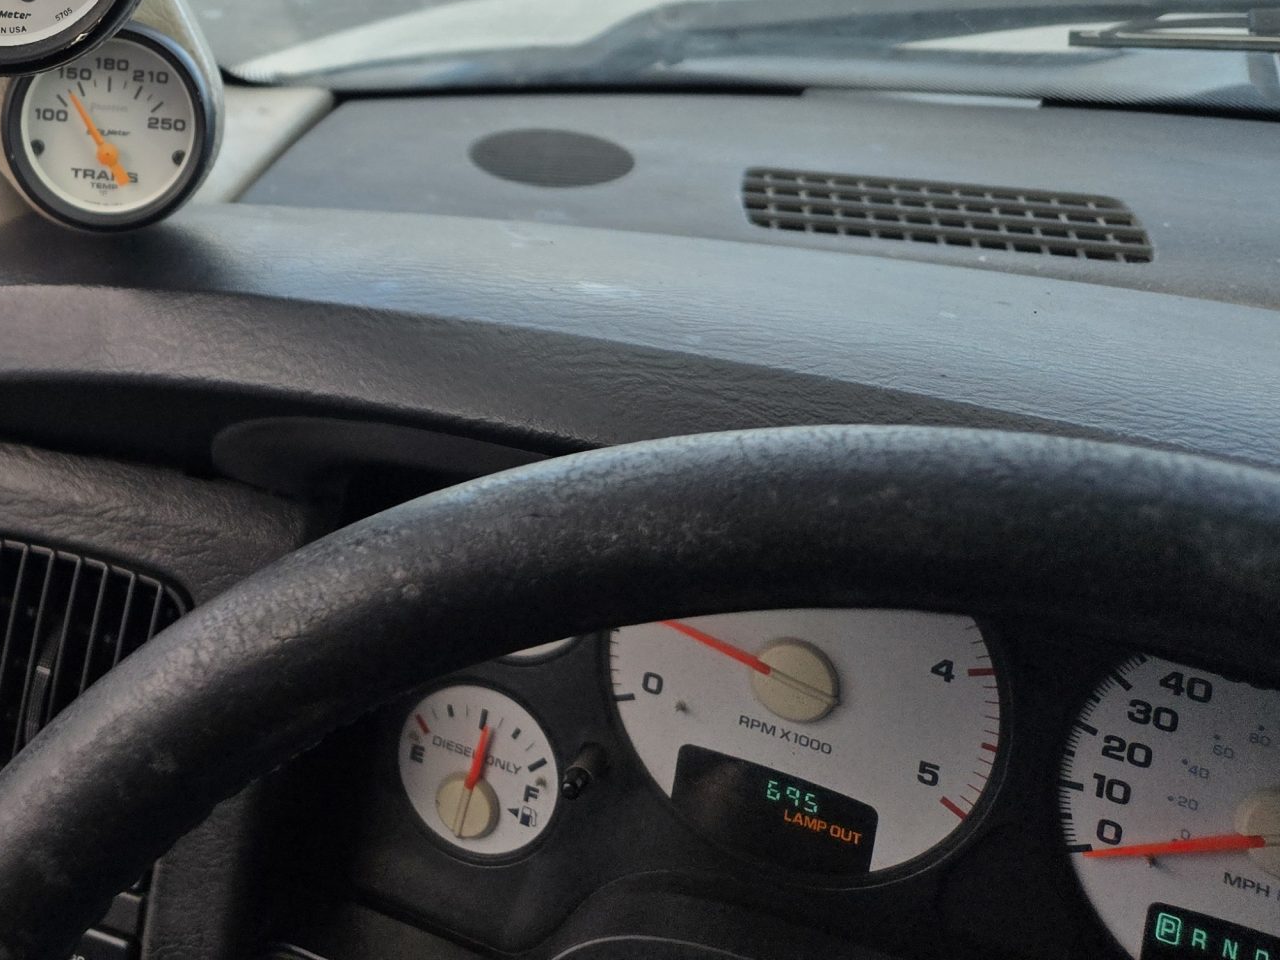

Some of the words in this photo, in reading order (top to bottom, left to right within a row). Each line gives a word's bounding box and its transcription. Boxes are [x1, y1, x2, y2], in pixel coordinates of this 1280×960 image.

[9, 25, 27, 34] USA
[58, 67, 92, 81] 150
[95, 57, 129, 71] 180
[133, 70, 169, 84] 210
[35, 108, 68, 122] 100
[148, 117, 186, 131] 250
[71, 167, 138, 183] TRAS
[930, 659, 955, 683] 4
[642, 672, 663, 695] 0
[1159, 671, 1213, 703] 40
[739, 715, 776, 736] RPM
[1127, 699, 1179, 732] 30
[410, 744, 425, 763] E
[1101, 734, 1153, 769] 20
[487, 756, 521, 775] ONLY
[917, 760, 940, 786] 5
[1188, 765, 1209, 780] 40
[523, 785, 539, 802] F
[766, 780, 818, 814] 695
[1093, 773, 1131, 805] 10
[1177, 795, 1199, 811] 20
[784, 809, 827, 833] LAMP
[830, 824, 862, 845] OUT
[1096, 819, 1123, 846] 0
[1224, 872, 1270, 897] MPH
[1192, 929, 1207, 950] R
[1222, 939, 1238, 960] N
